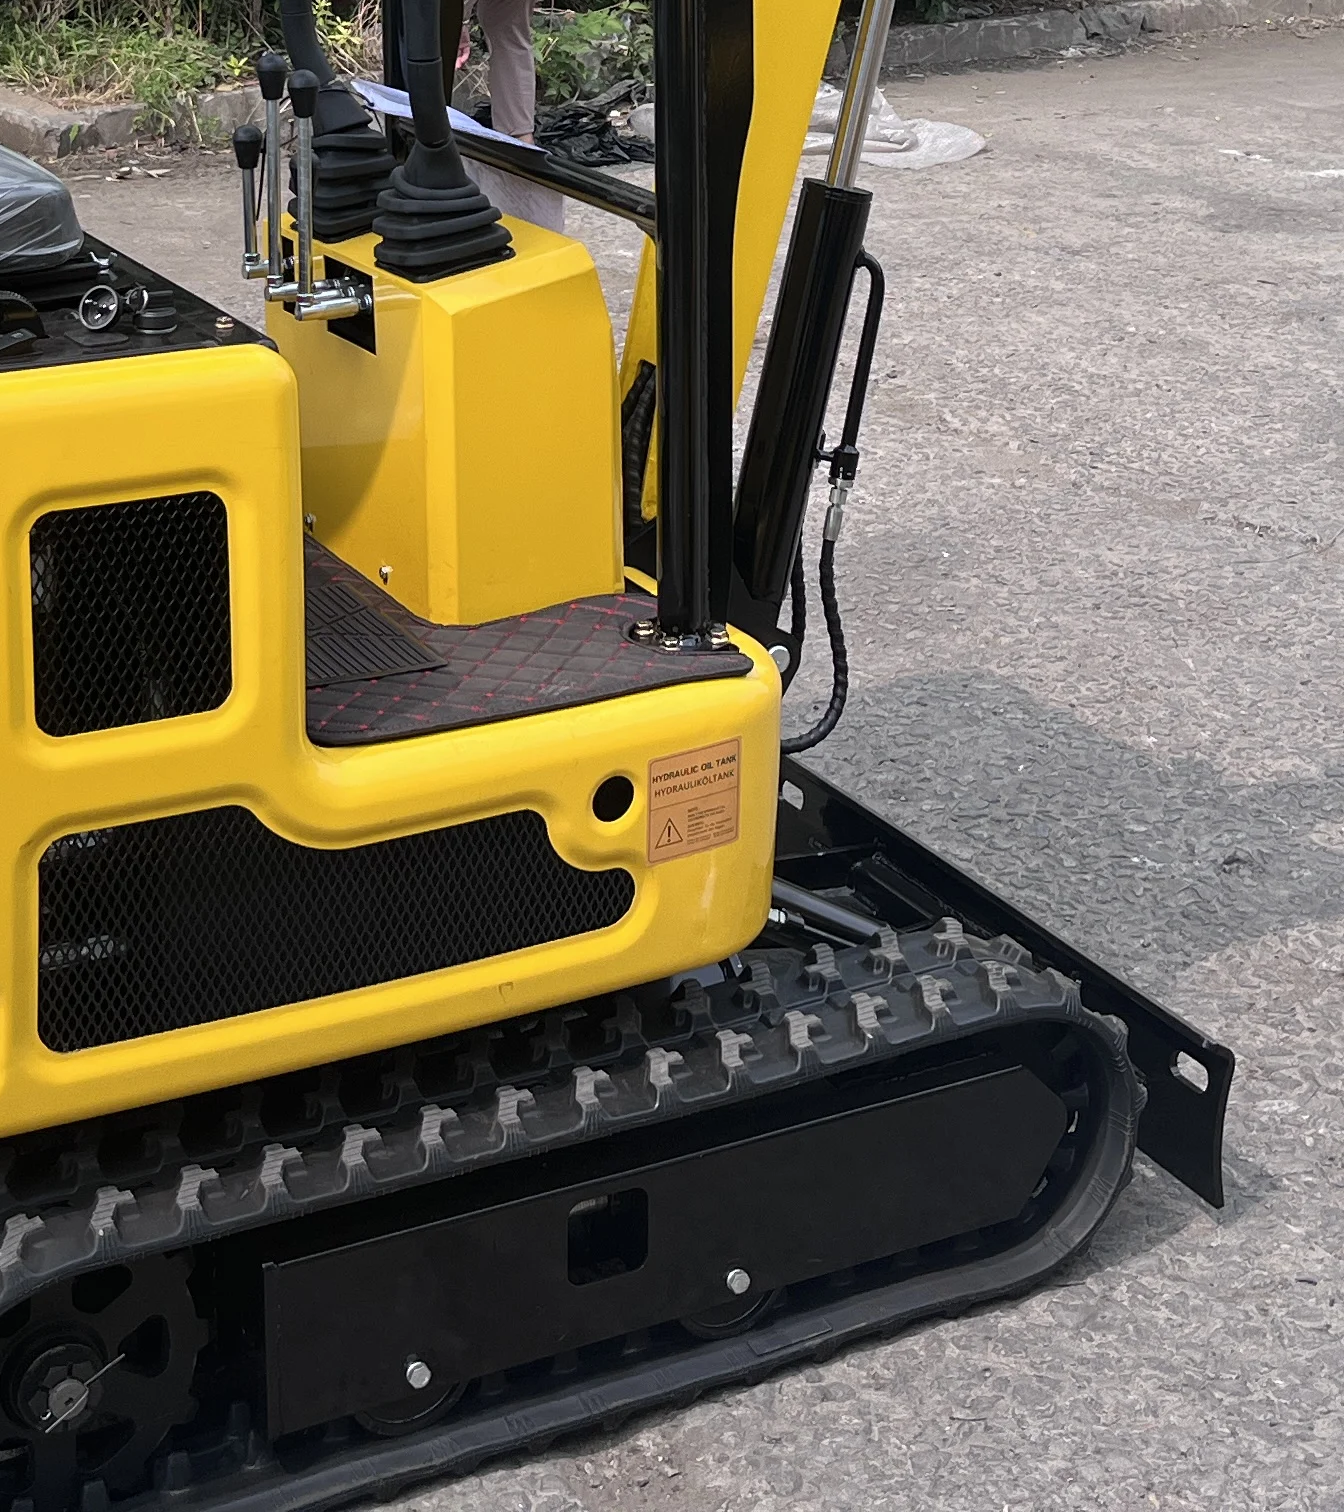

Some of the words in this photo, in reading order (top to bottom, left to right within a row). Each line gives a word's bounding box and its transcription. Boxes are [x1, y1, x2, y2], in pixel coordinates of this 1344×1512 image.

[652, 765, 698, 784] HYDRAULIC
[701, 762, 713, 771] OIL
[716, 754, 736, 767] TANK
